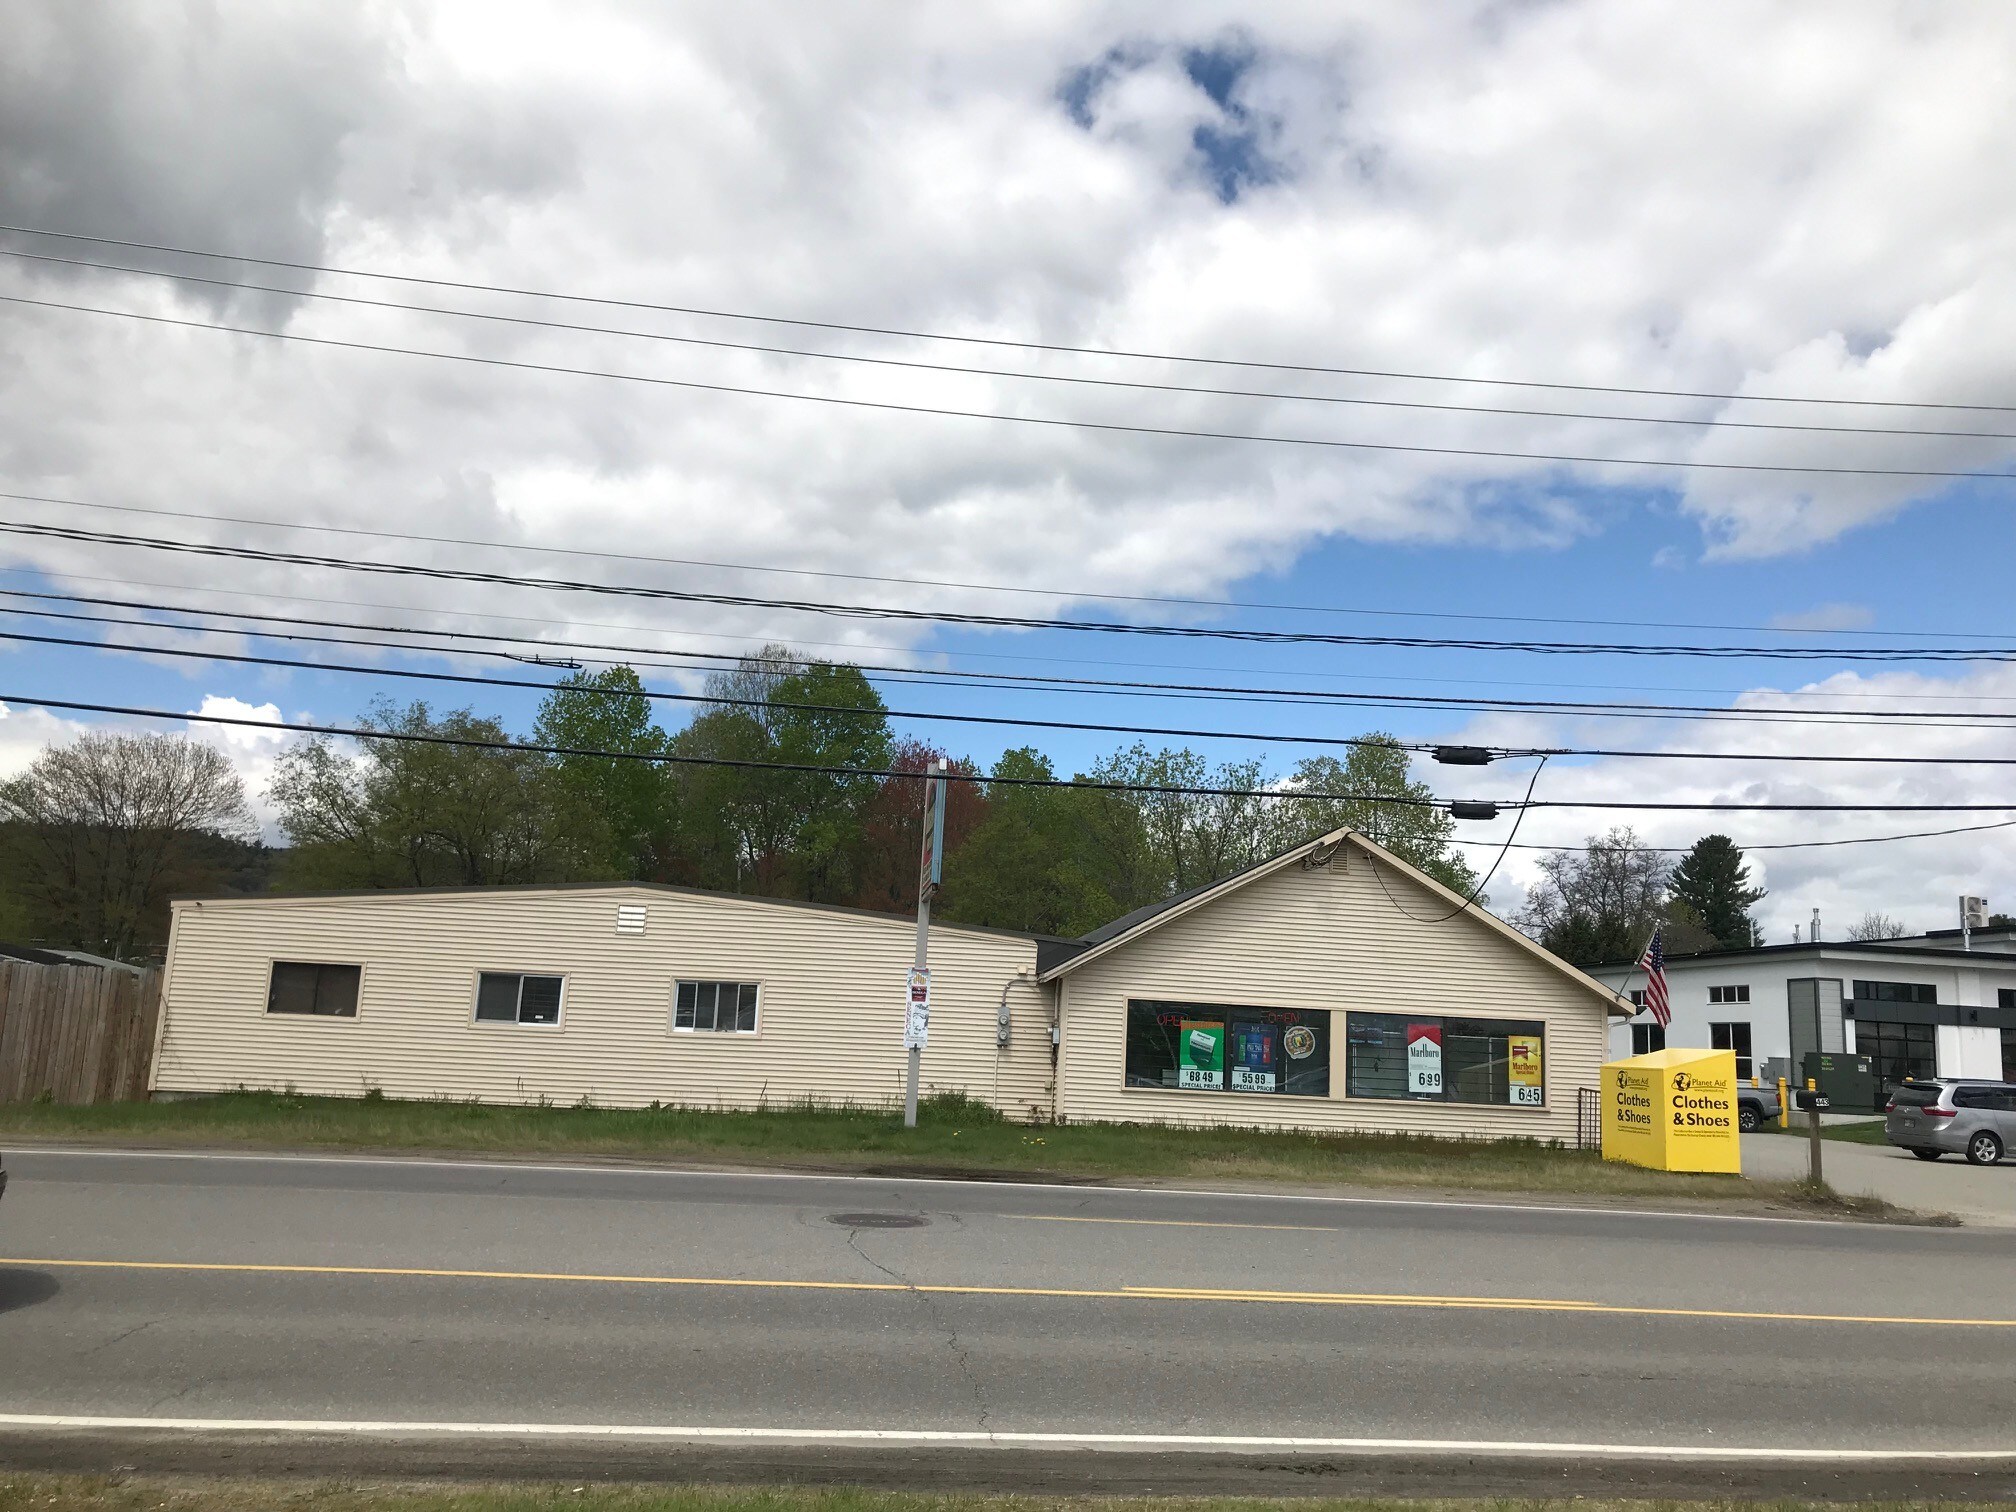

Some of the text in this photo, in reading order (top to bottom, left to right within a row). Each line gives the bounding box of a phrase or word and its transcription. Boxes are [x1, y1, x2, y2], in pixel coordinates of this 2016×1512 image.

[1410, 1043, 1440, 1058] Marlboro
[1512, 1062, 1538, 1071] Marlboro
[1232, 1083, 1256, 1091] SPECIAL
[1627, 1076, 1640, 1084] Planet
[1692, 1078, 1727, 1087] Planet Aid
[1616, 1092, 1651, 1107] Clothes
[1672, 1095, 1729, 1110] Clothes
[1617, 1108, 1651, 1124] & Shoes
[1673, 1112, 1730, 1127] & Shoes
